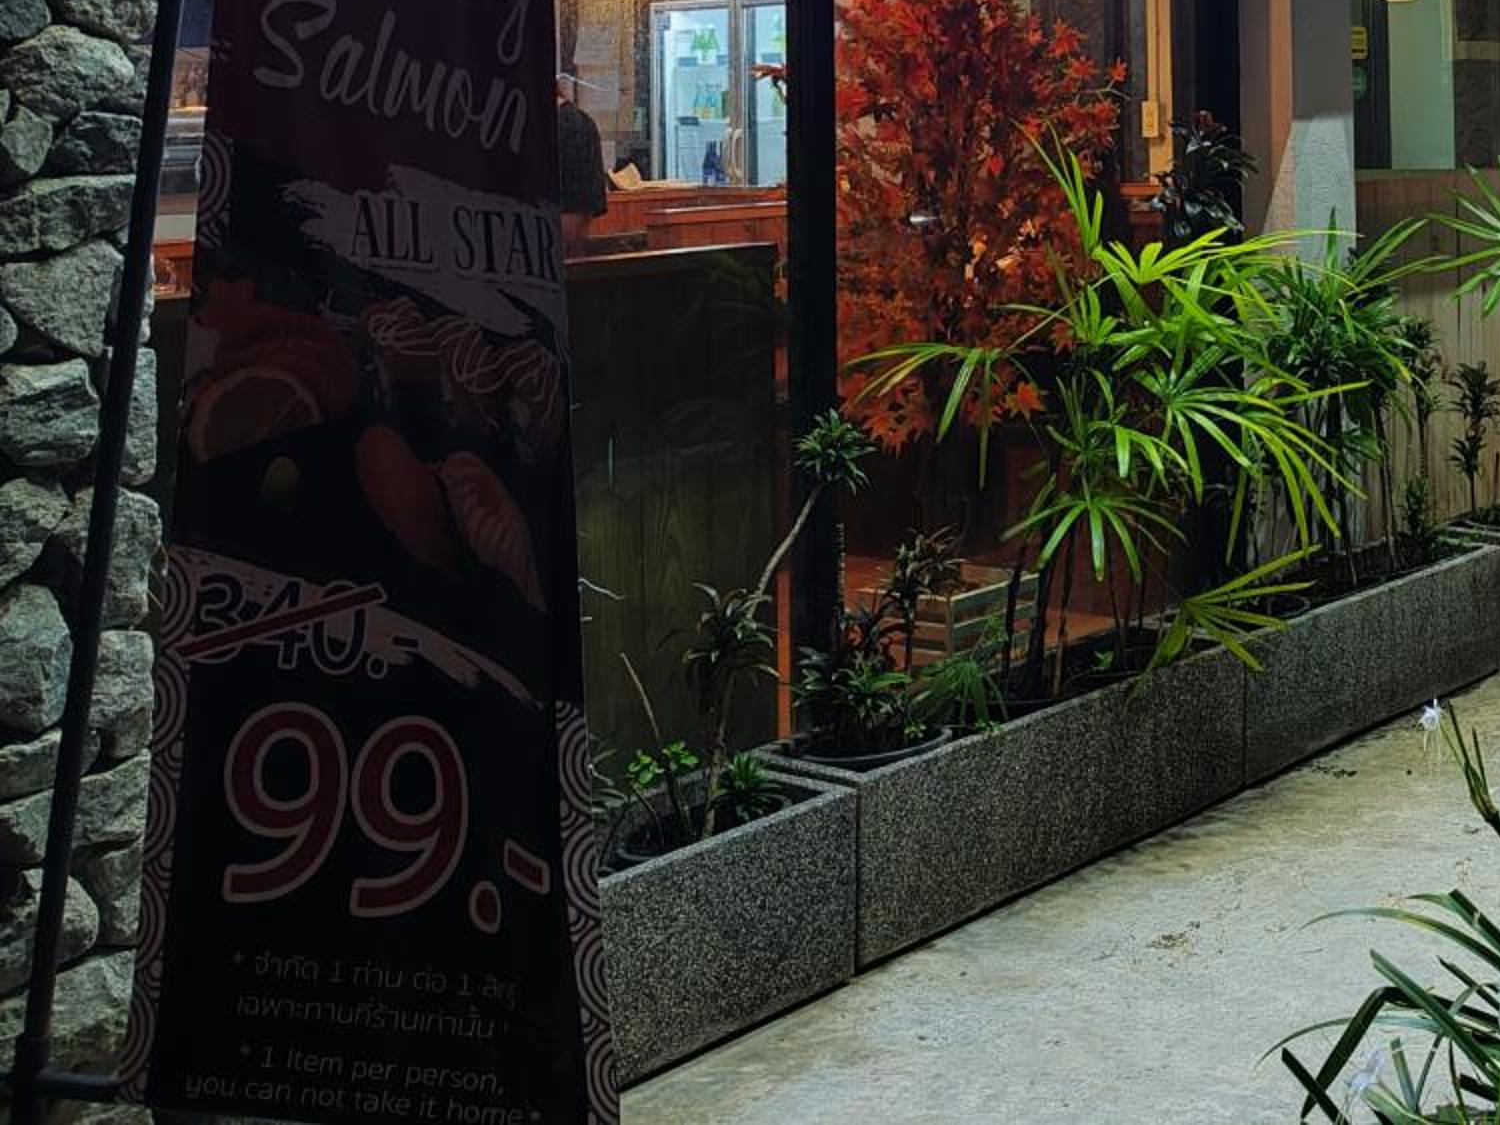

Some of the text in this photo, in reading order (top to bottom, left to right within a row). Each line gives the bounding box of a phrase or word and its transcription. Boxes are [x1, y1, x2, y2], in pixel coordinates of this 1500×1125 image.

[351, 196, 560, 279] ALL STAR
[222, 701, 550, 933] 99.-
[185, 1072, 523, 1125] you can not take it home
[351, 1060, 398, 1084] per
